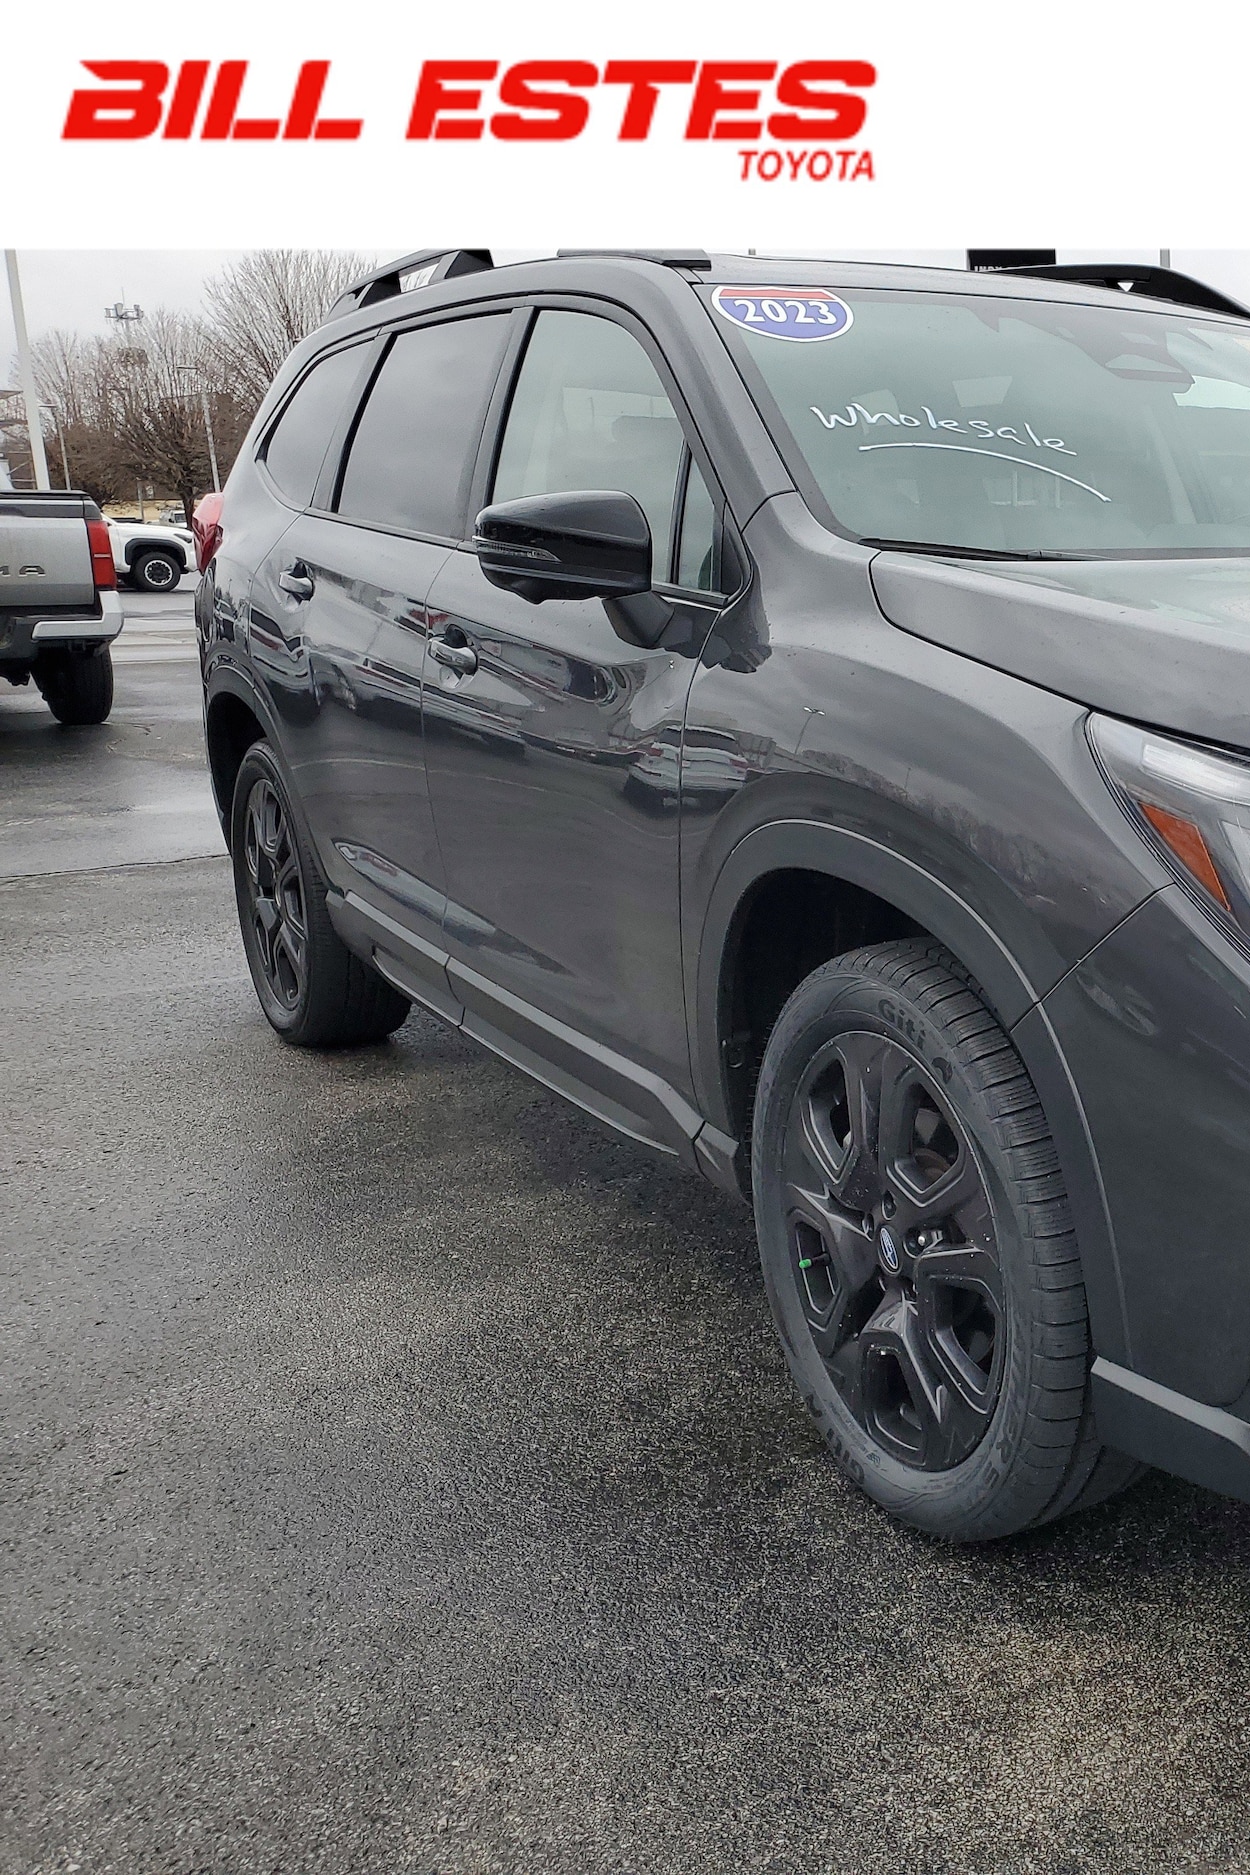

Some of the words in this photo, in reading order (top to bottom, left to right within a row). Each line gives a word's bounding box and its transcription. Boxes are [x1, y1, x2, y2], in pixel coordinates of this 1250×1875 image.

[734, 299, 837, 325] 2023
[810, 402, 1077, 456] Wholesale
[878, 998, 926, 1051] Giti
